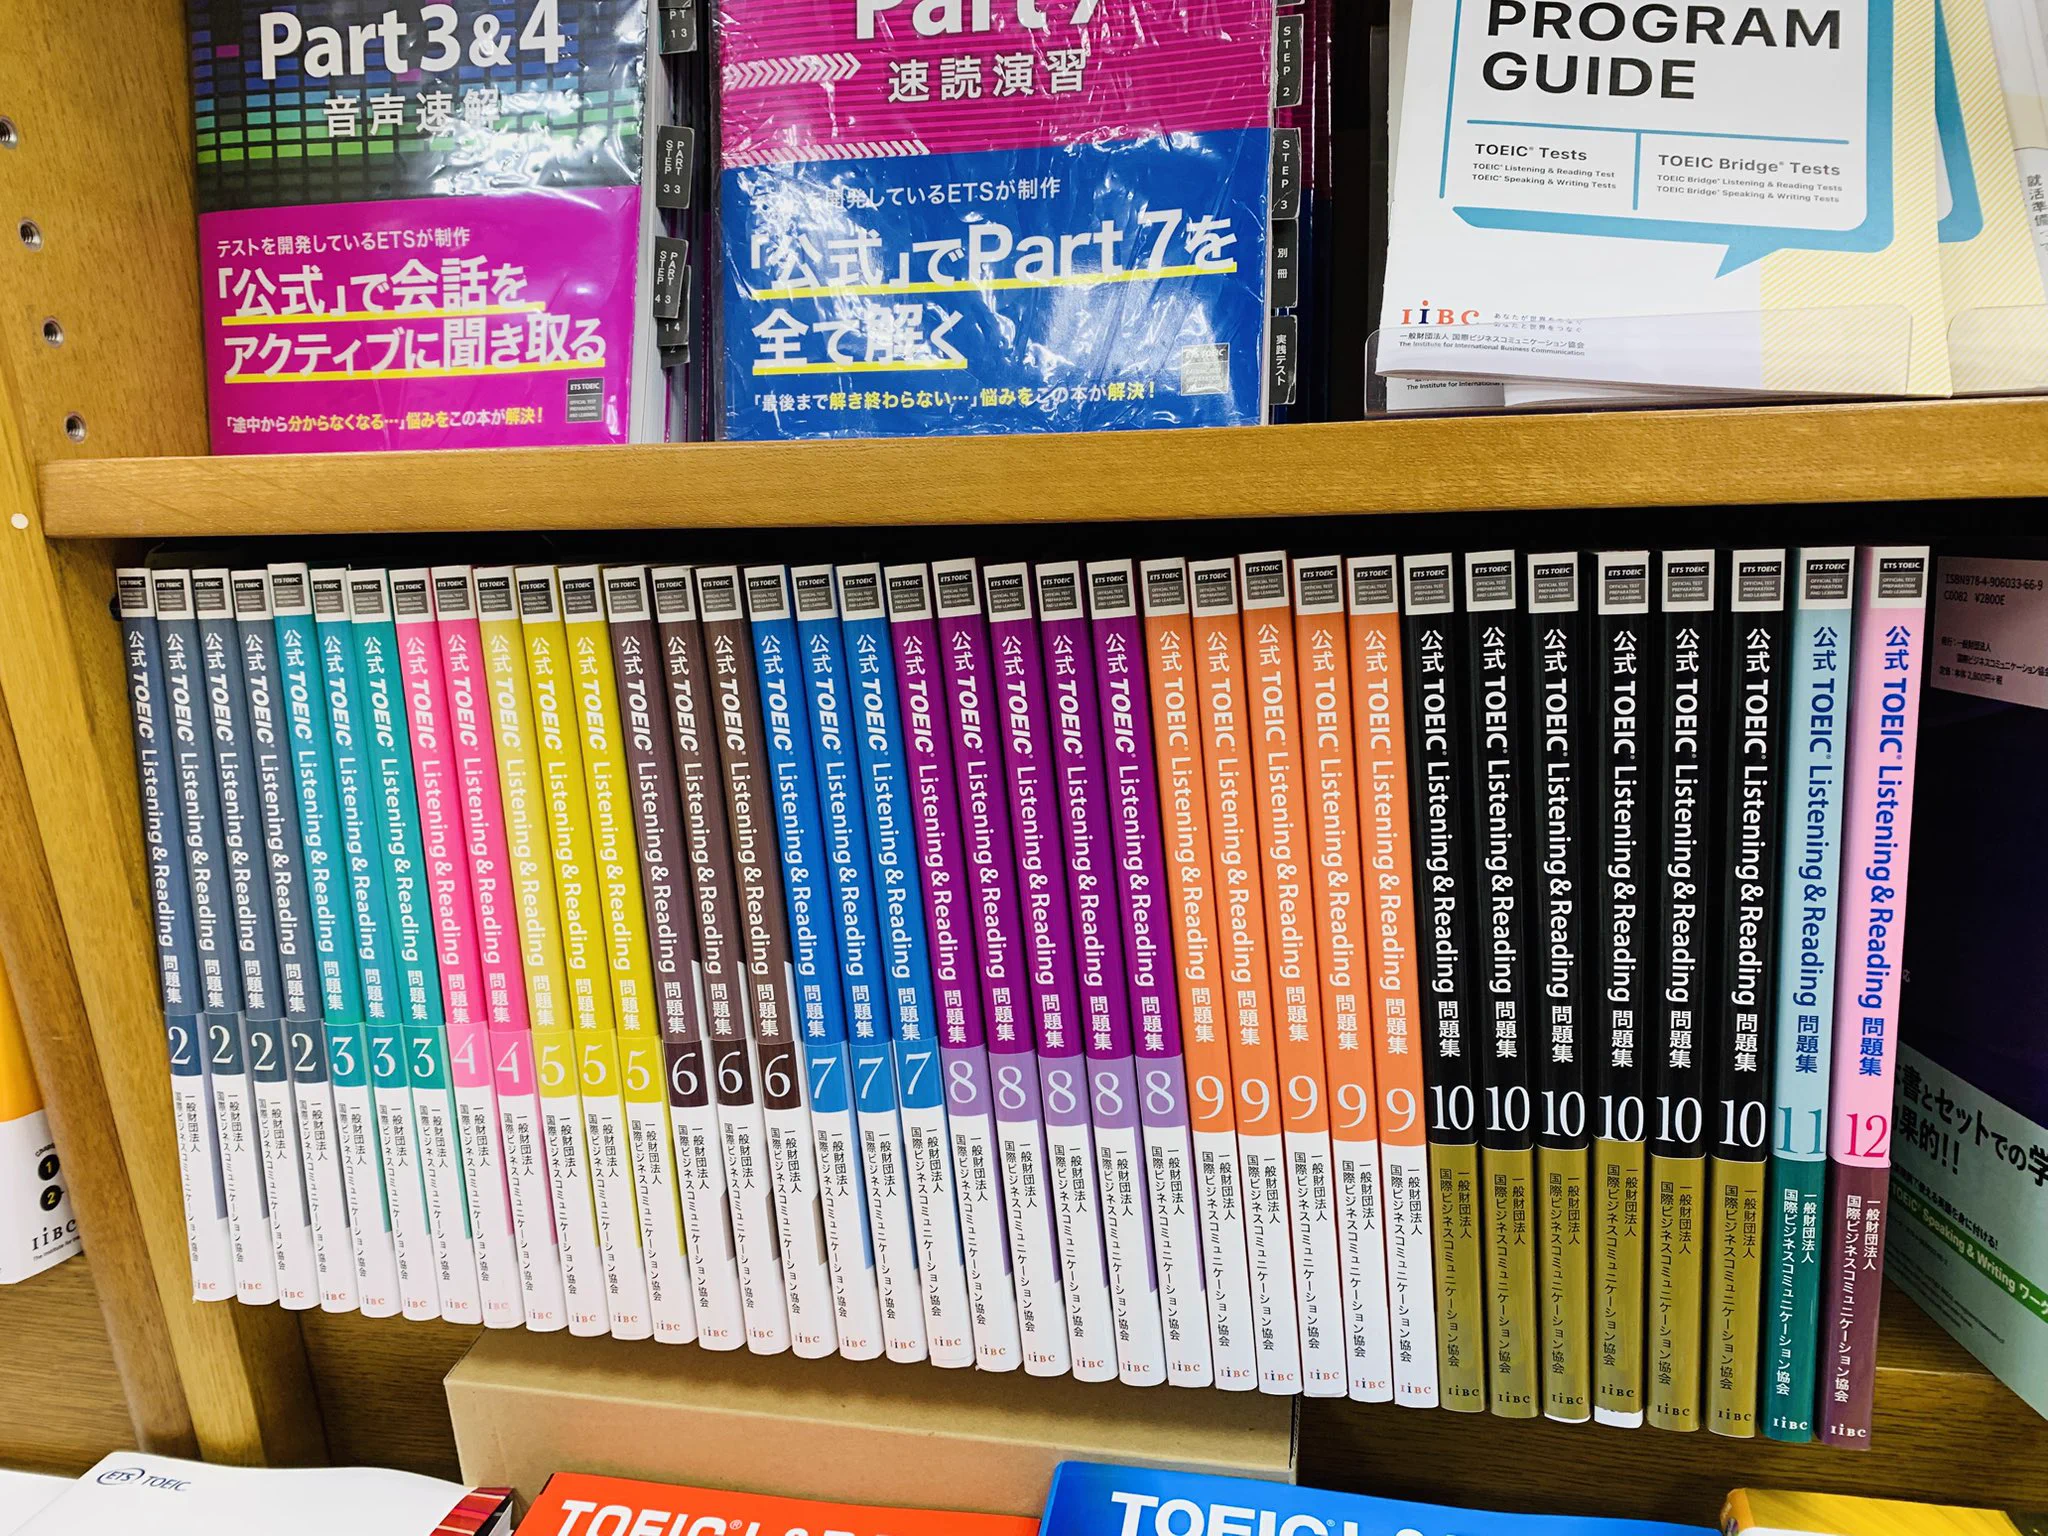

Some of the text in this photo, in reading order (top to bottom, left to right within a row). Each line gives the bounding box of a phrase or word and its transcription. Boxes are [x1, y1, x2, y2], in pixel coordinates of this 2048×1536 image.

[259, 10, 409, 80] Part
[1487, 0, 1841, 50] PROGRAM
[888, 49, 1089, 103] 速読演習
[1282, 26, 1292, 98] STEP 2
[1482, 51, 1697, 101] GUIDE
[323, 88, 501, 138] 音声速解
[663, 139, 674, 194] STEP 3
[674, 140, 685, 195] PART 3
[1279, 140, 1290, 210] STEP 3
[1505, 165, 1546, 175] Listening
[1556, 168, 1593, 178] Reading
[1539, 147, 1588, 161] Tests
[1658, 154, 1714, 169] TOEIC
[1790, 162, 1841, 177] Tests
[1504, 176, 1545, 186] Speaking
[1556, 179, 1590, 188] Writing
[1657, 174, 1685, 183] TOEIC
[1722, 178, 1765, 189] Listening
[1776, 182, 1815, 192] Reading
[1817, 184, 1843, 192] Tests
[1657, 185, 1685, 194] TOEIC
[1722, 189, 1765, 200] Speaking
[1777, 193, 1811, 202] Writing
[1814, 195, 1840, 203] Tests
[216, 226, 471, 258] テストを開発しているETSが制作
[1277, 247, 1289, 279] 別冊
[217, 254, 528, 318] 「公式」で会話を
[655, 250, 667, 304] STEP 4
[664, 252, 679, 305] PART 3
[223, 312, 607, 377] アクティブに聞き取る
[674, 322, 681, 332] 4
[752, 302, 966, 367] 全て解く
[1400, 332, 1585, 350] 一般財団法人 国際ビジネスコミュニケーション協会
[1455, 343, 1499, 351] International
[1500, 345, 1530, 353] Business
[1531, 347, 1585, 356] Communication
[1275, 333, 1287, 387] 実践テスト
[570, 382, 600, 391] ETS TOEIC
[1420, 382, 1447, 390] Institute
[1883, 561, 1921, 570] ETS TOEIC
[128, 630, 148, 668] 公式
[1105, 633, 1129, 674] 公式
[1675, 628, 1700, 673] 公式
[1813, 626, 1838, 671] 公式
[1884, 625, 1911, 671] 公式
[141, 749, 164, 849] Listening
[1118, 765, 1146, 871] Listening
[1667, 765, 1698, 878] Listening
[1799, 765, 1833, 880] Listening
[1865, 766, 1903, 881] Listening
[154, 864, 175, 947] Reading
[1131, 894, 1157, 987] Reading
[1665, 903, 1696, 1003] Reading
[1793, 906, 1827, 1006] Reading
[1857, 908, 1895, 1009] Reading
[163, 955, 182, 1004] 問題集
[168, 1025, 192, 1065] 2
[1141, 996, 1165, 1052] 問題集
[1669, 1010, 1692, 1069] 問題集
[1795, 1015, 1820, 1074] 問題集
[1859, 1016, 1885, 1077] 問題集
[372, 1037, 396, 1077] 3
[496, 1040, 520, 1084] 4
[583, 1044, 607, 1085] 5
[764, 1053, 791, 1098] 6
[905, 1051, 932, 1095] 7
[1145, 1070, 1175, 1115] 8
[1386, 1088, 1416, 1133] 9
[1656, 1096, 1702, 1143] 10
[1777, 1106, 1825, 1155] 11
[1845, 1112, 1888, 1158] 12
[1893, 1104, 1960, 1176] 果的!!
[1896, 1064, 2048, 1187] 書とセットでの学
[45, 1161, 52, 1173] 1
[1115, 1150, 1134, 1217] 一般財団法人
[47, 1191, 56, 1205] 2
[1100, 1147, 1130, 1341] 国際ビジネスコミュニケーション協会
[1801, 1192, 1818, 1264] 一般財団法人
[1862, 1200, 1881, 1271] 一般財団法人
[1922, 1207, 1965, 1254] Speaking
[1966, 1243, 1975, 1260] &
[1976, 1249, 2016, 1294] Writing
[1776, 1188, 1799, 1396] 国際ビジネスコミュニケーション協会
[1834, 1195, 1862, 1402] 国際ビジネスコミュニケーション協会
[106, 1471, 192, 1492] ETS TOEIC
